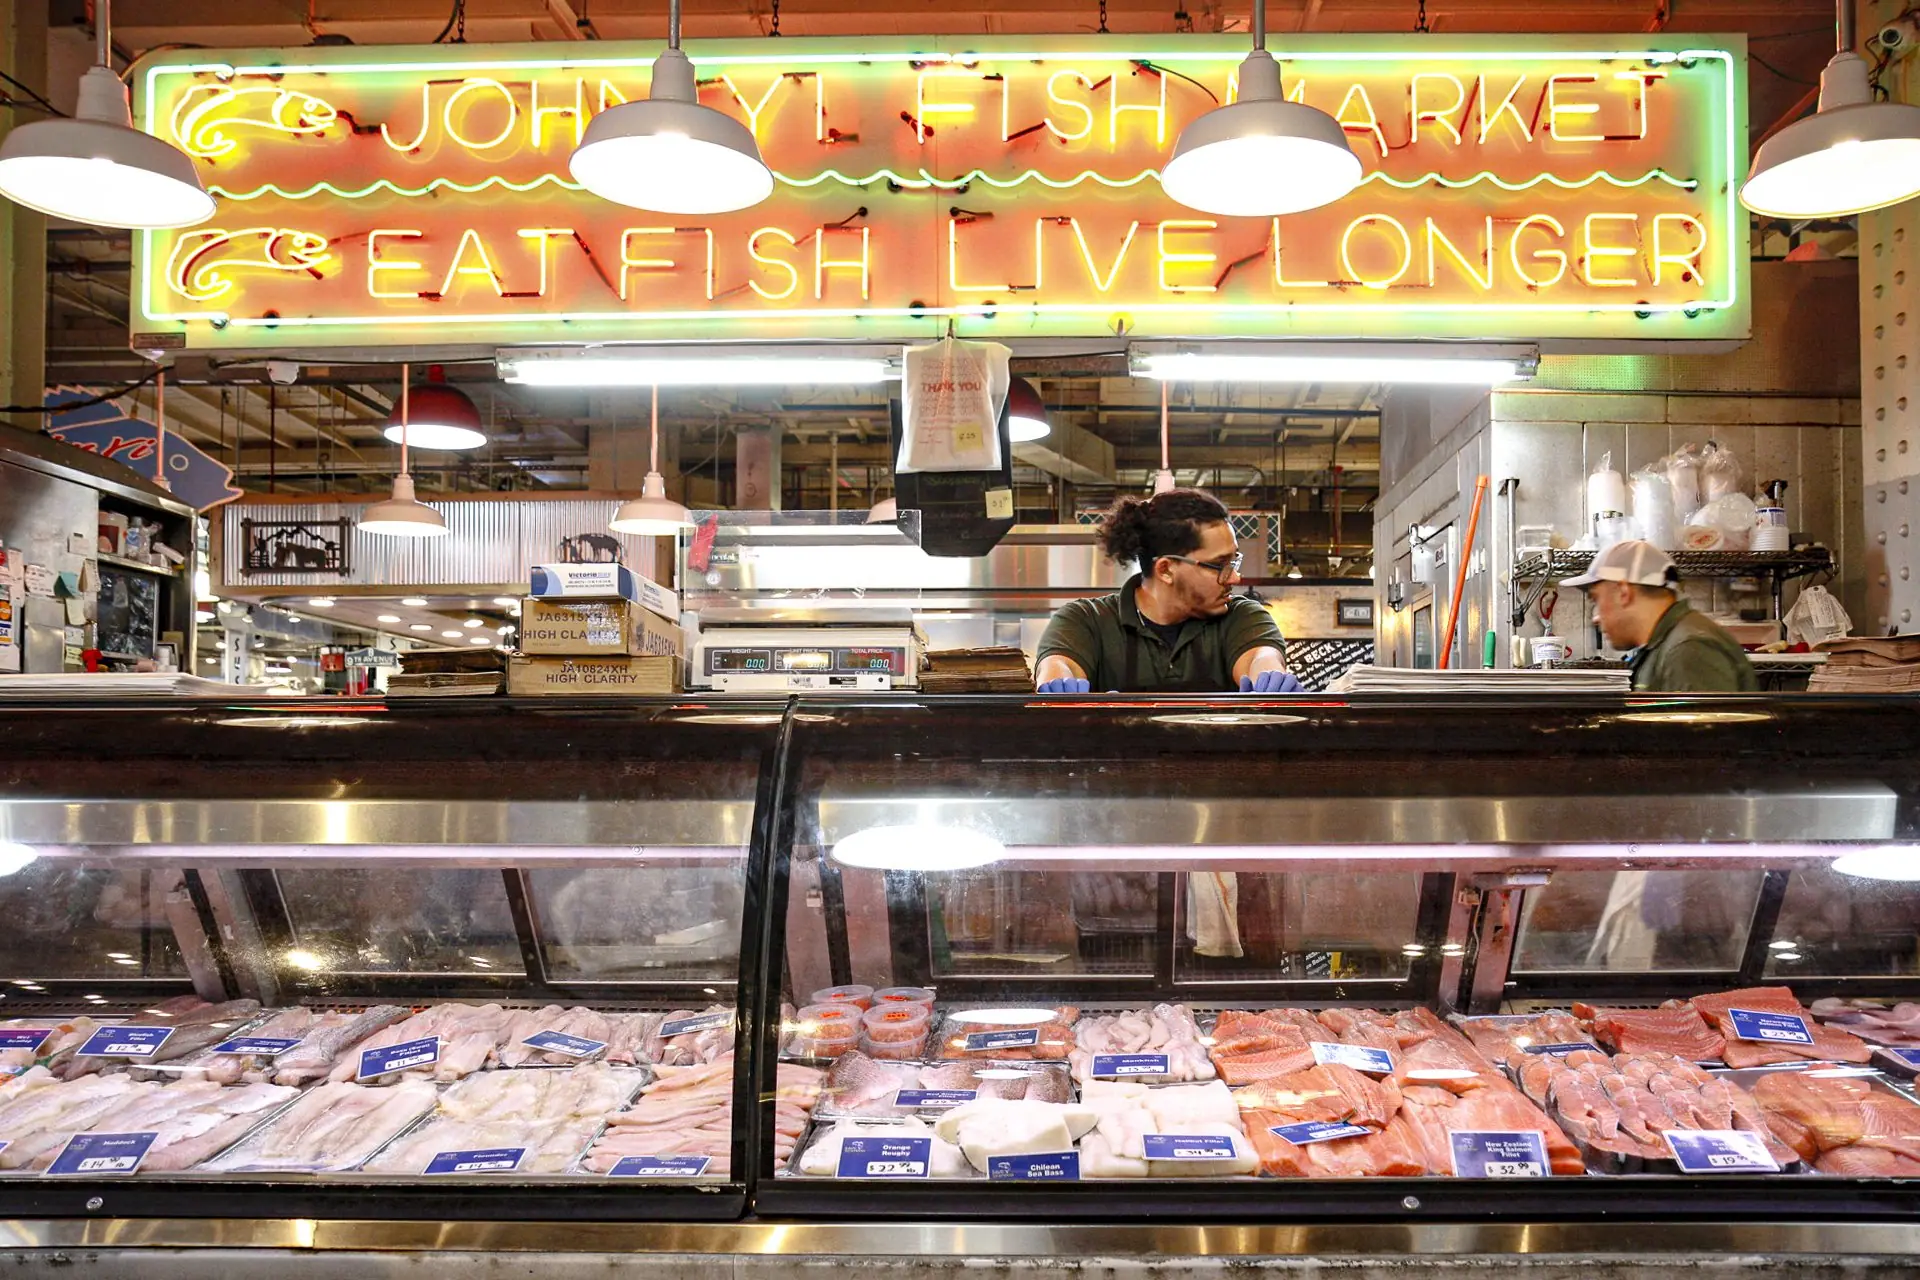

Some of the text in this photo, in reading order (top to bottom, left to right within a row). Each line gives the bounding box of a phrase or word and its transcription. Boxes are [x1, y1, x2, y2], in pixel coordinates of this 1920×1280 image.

[915, 69, 1168, 146] FISH
[367, 213, 1708, 301] EAT FISH LIVE LONGER
[921, 381, 982, 393] THANK YOU
[523, 629, 557, 640] HIGH
[1304, 640, 1343, 663] BECK'S
[362, 656, 394, 664] AVENUE
[560, 664, 629, 675] JA10824XH
[546, 674, 638, 684] HIGH CLARITY
[882, 1144, 912, 1152] Orange
[1722, 1156, 1736, 1165] 19
[1030, 1163, 1061, 1171] Chilean
[1027, 1169, 1065, 1178] Sea Bass
